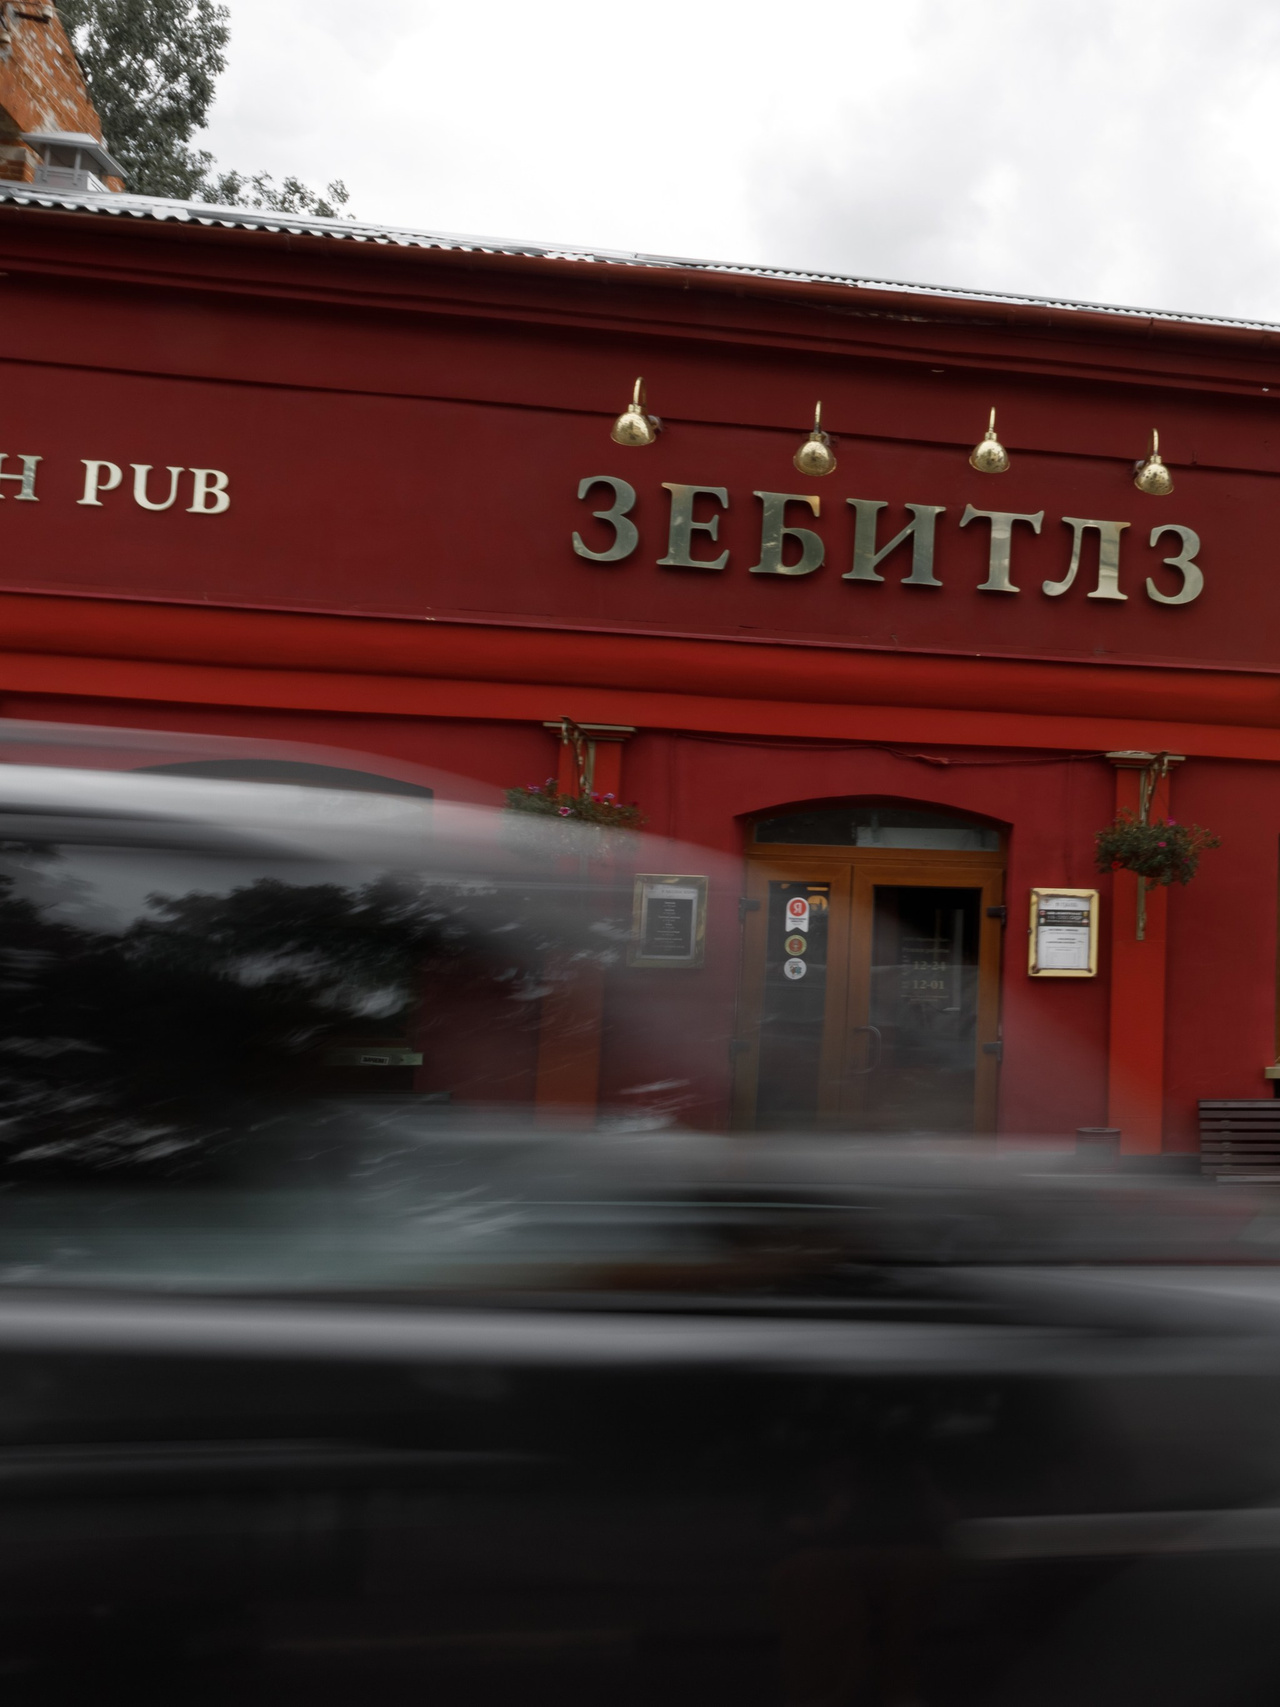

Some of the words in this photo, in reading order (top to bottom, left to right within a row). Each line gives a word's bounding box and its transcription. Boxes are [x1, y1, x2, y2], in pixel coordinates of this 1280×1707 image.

[76, 459, 231, 515] PUB
[571, 475, 1205, 606] ЗЕБИТЛЗ
[912, 979, 945, 990] 12-01
